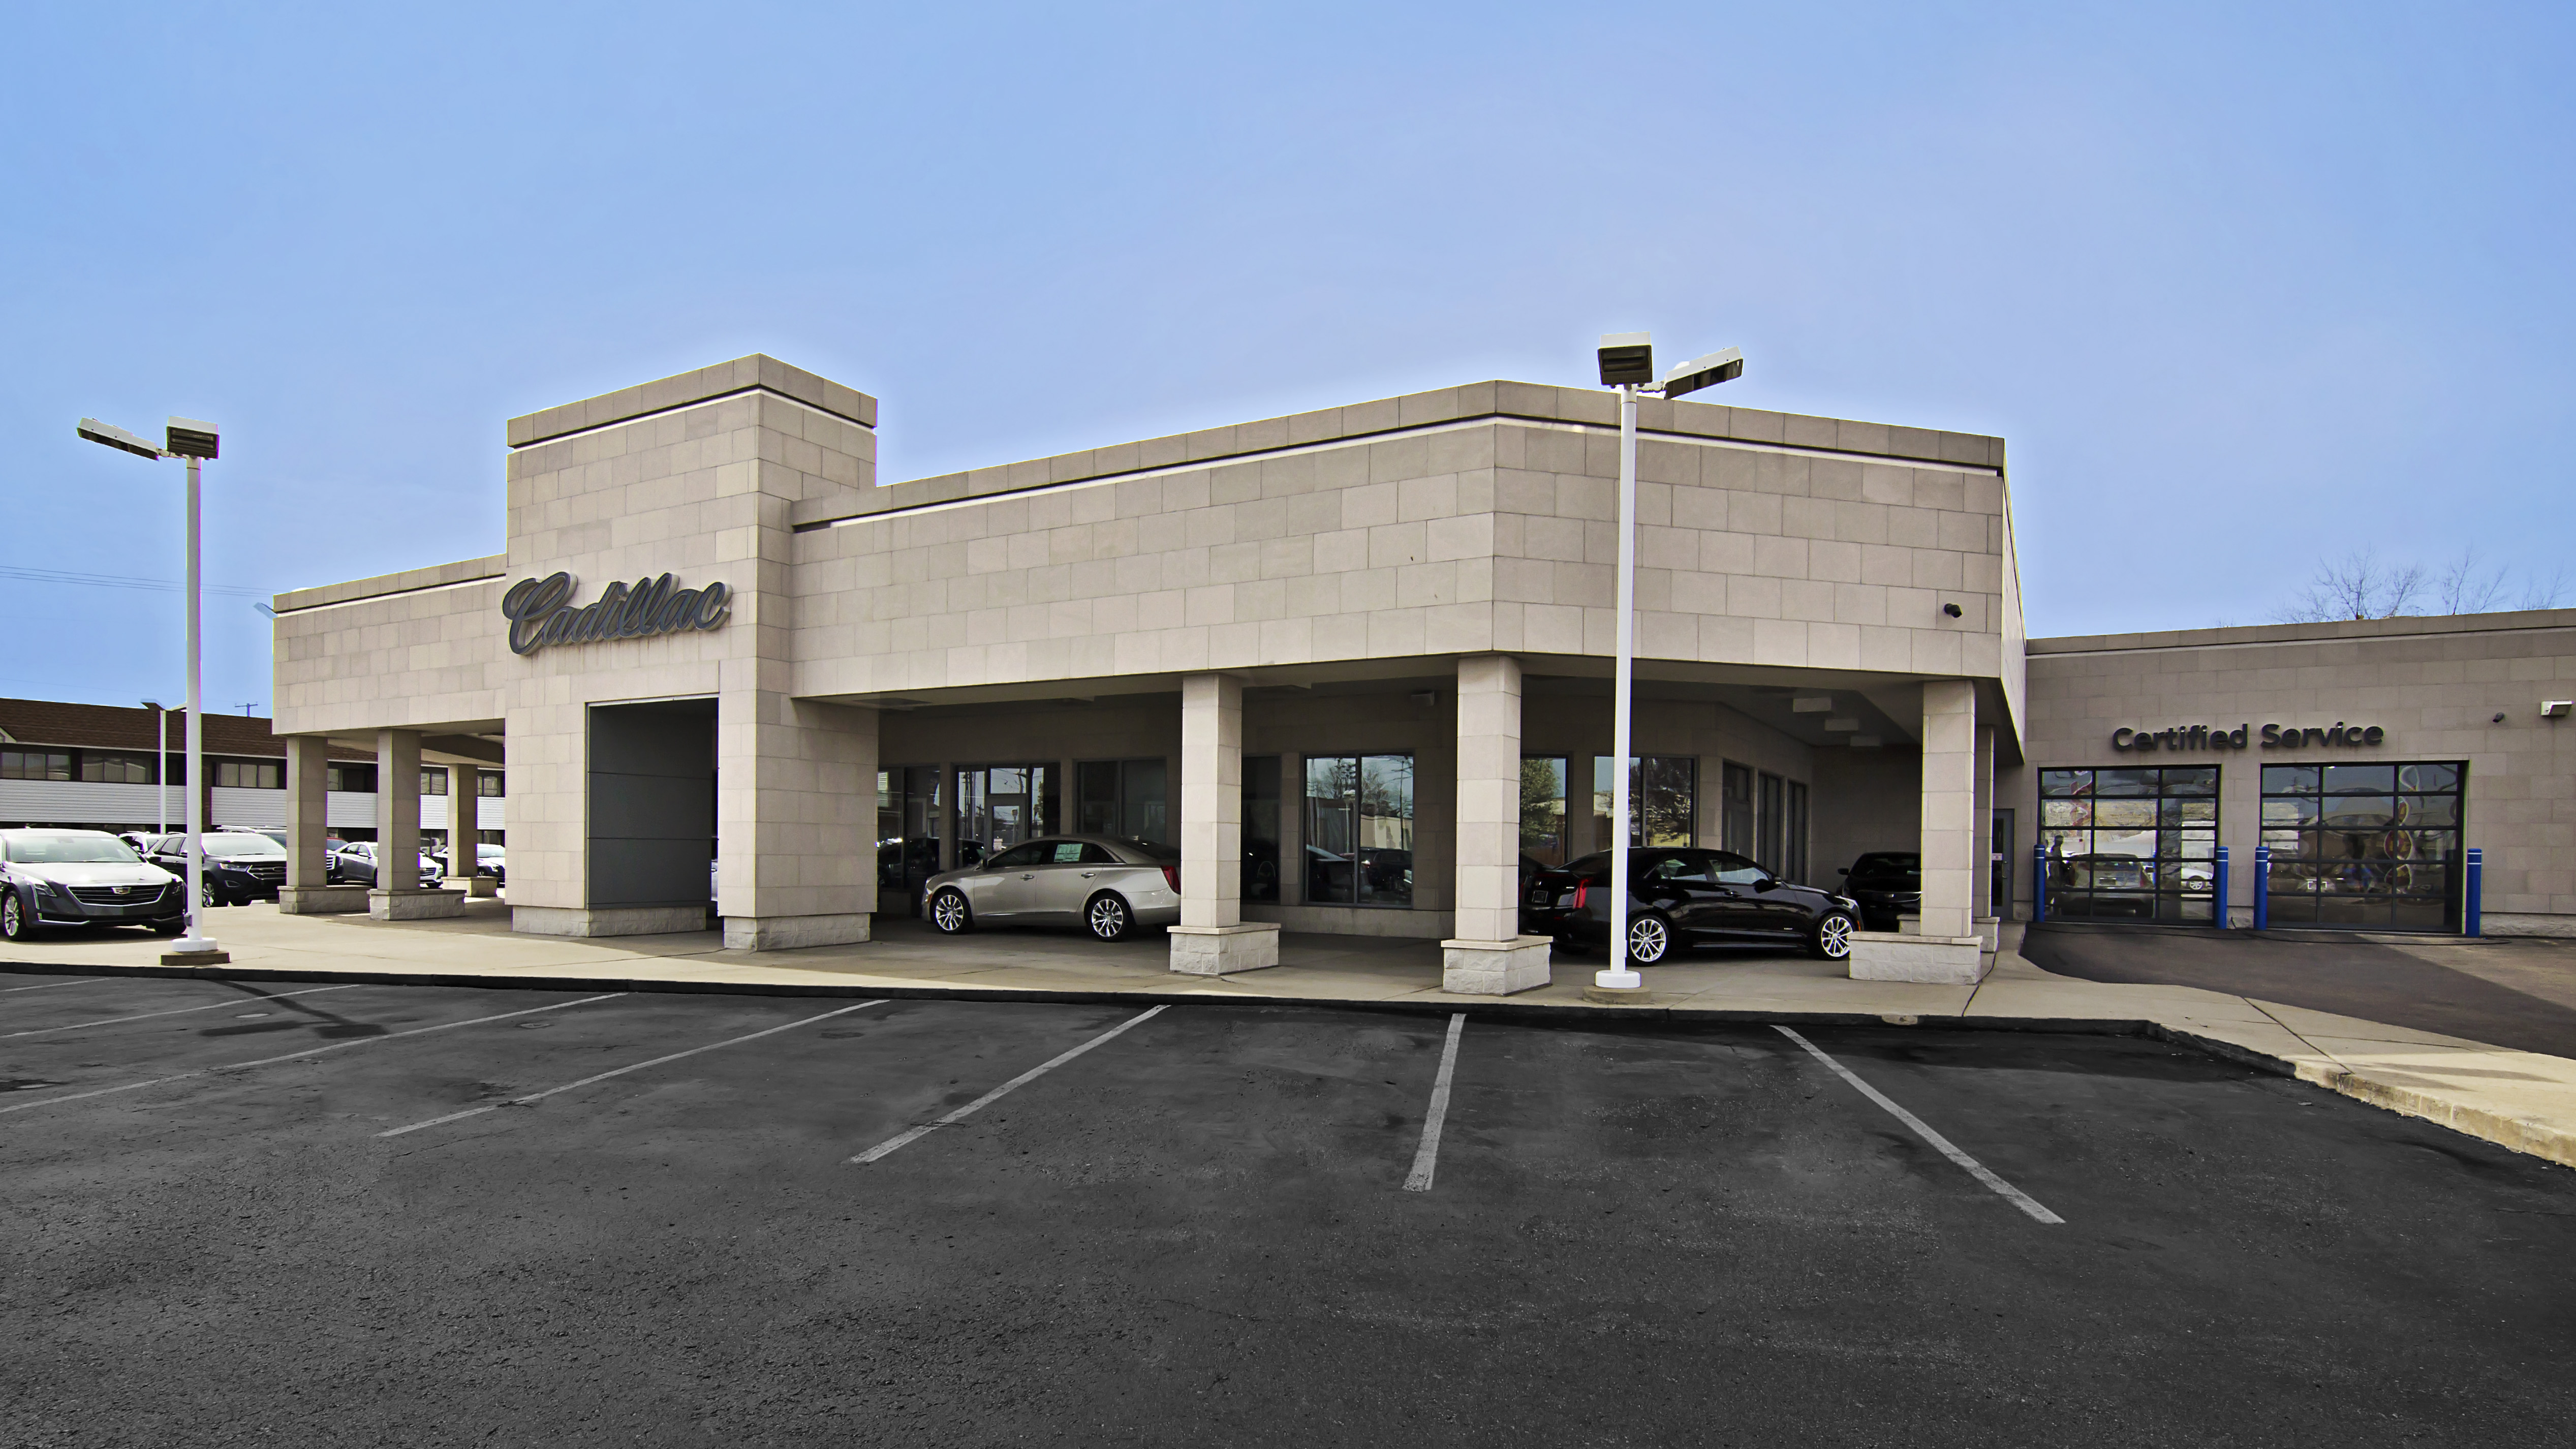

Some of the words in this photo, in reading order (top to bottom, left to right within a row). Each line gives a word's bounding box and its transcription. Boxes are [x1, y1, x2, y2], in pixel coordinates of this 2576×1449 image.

[503, 571, 732, 656] Cadillac
[2113, 723, 2248, 751] Certified
[2260, 722, 2384, 748] Service
